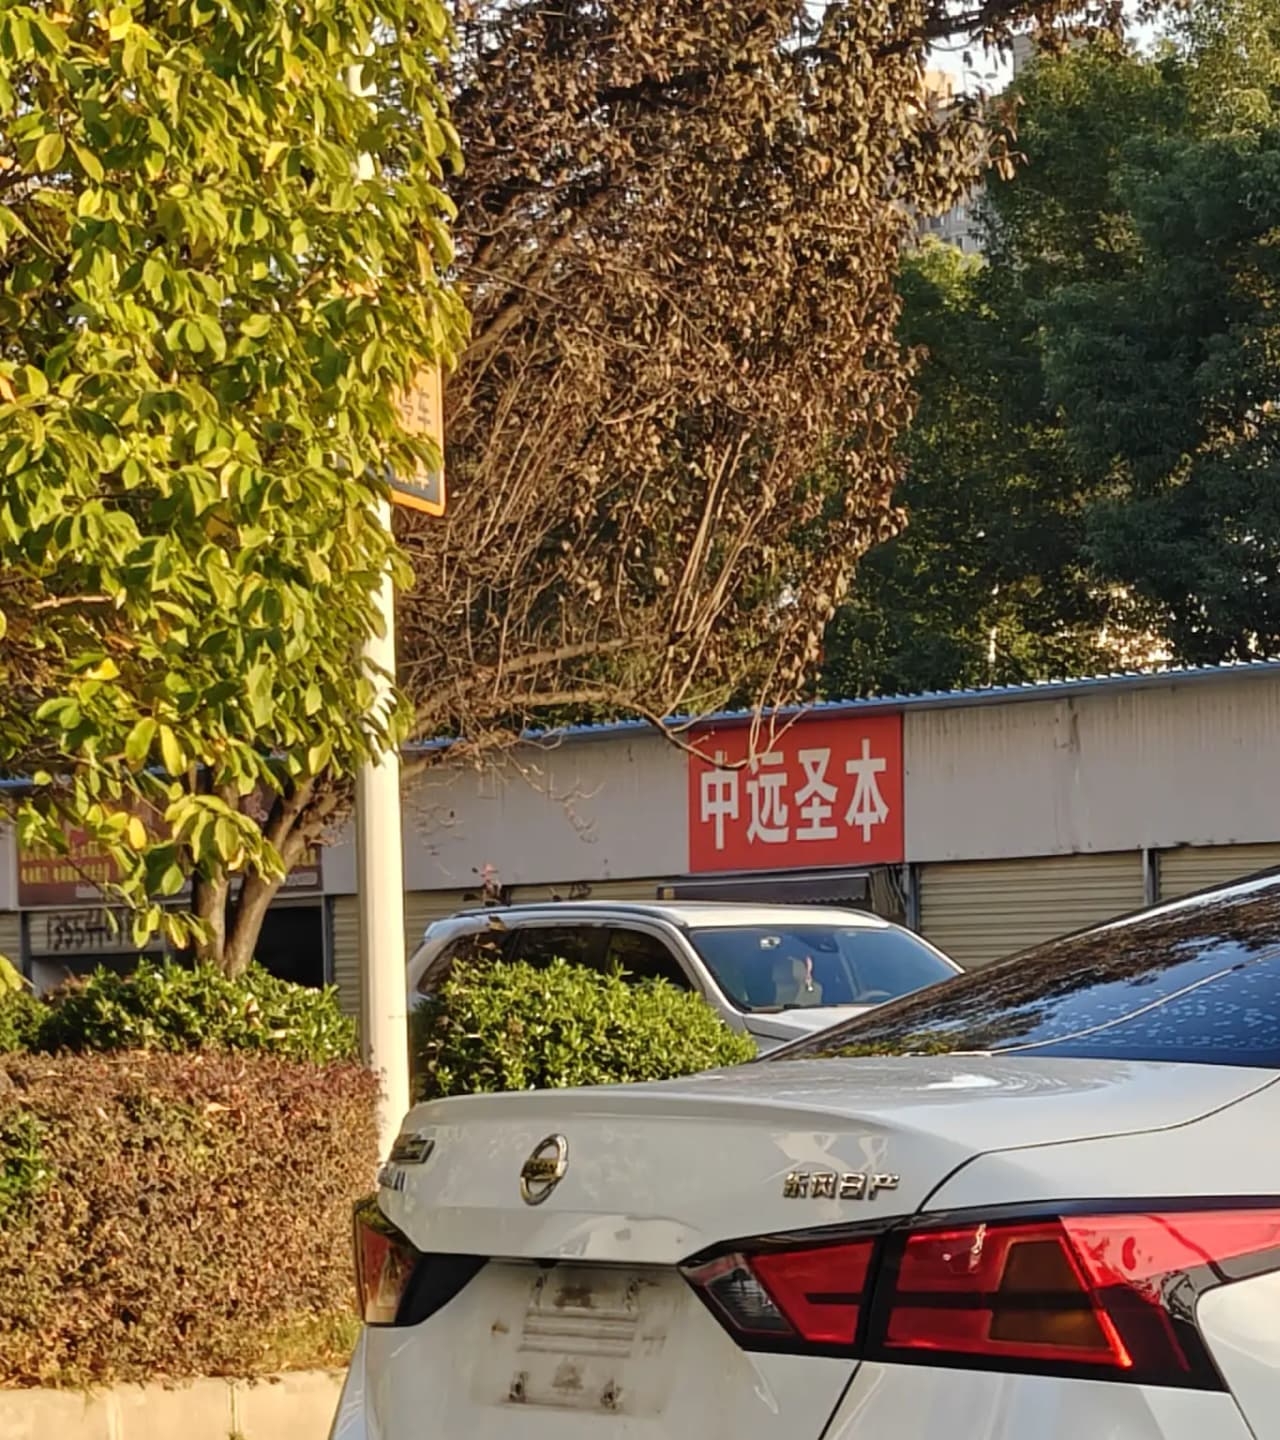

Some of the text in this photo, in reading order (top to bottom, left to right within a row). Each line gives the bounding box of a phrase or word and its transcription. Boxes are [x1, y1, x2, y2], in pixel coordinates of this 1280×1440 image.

[700, 737, 889, 850] 中远圣本
[783, 1170, 900, 1201] 东风日产
